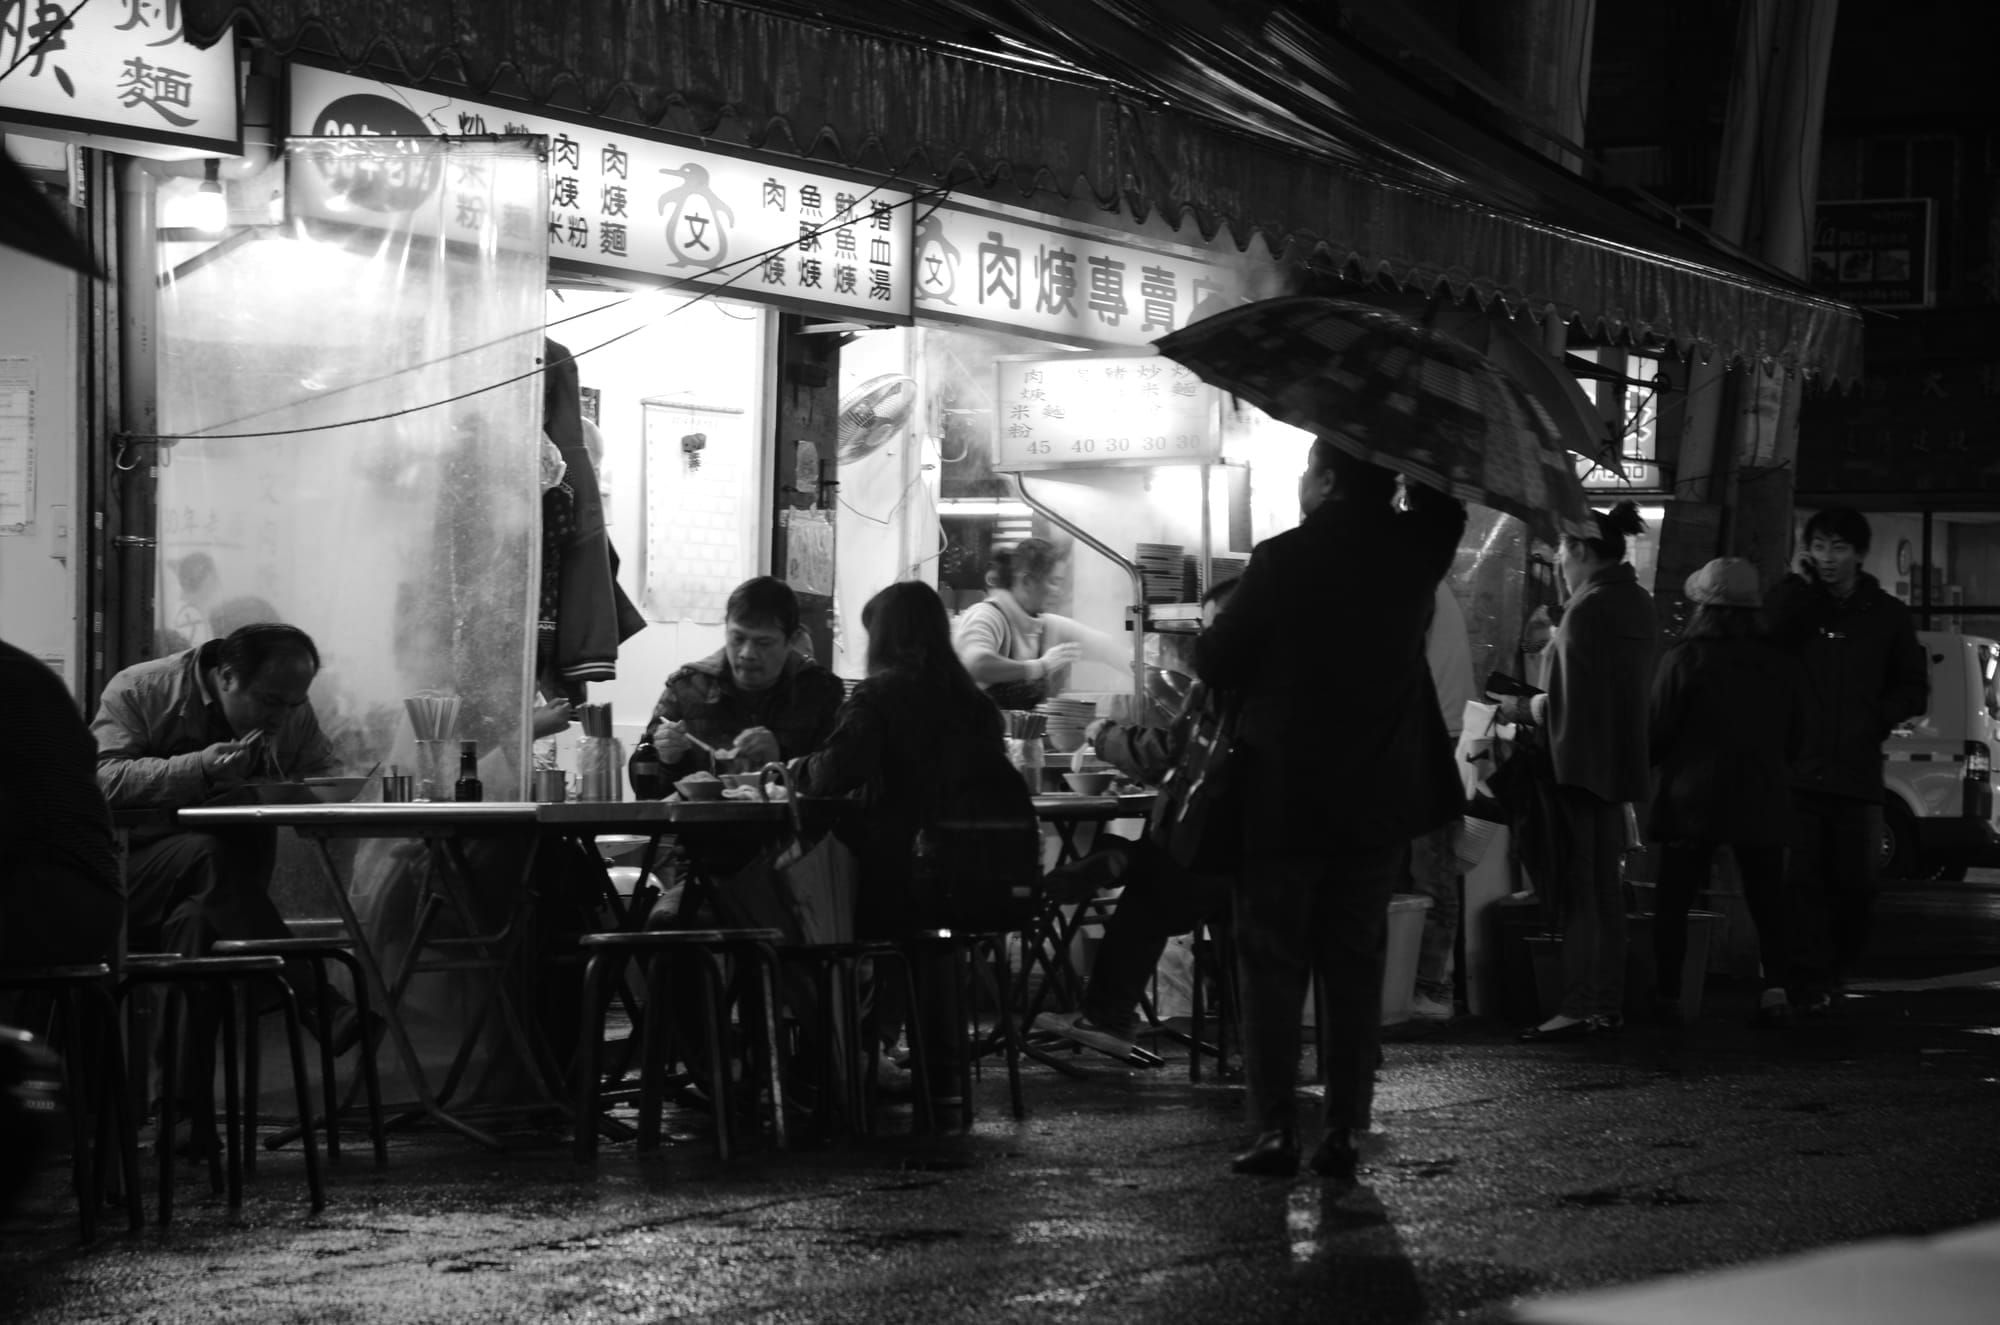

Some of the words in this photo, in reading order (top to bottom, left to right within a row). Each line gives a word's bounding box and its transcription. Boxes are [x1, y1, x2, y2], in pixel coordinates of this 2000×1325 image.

[684, 212, 711, 252] 文
[925, 253, 944, 287] 文
[1026, 440, 1052, 455] 45
[1071, 438, 1095, 454] 40
[1105, 437, 1130, 452] 30
[1143, 435, 1167, 451] 30
[1175, 433, 1200, 450] 30
